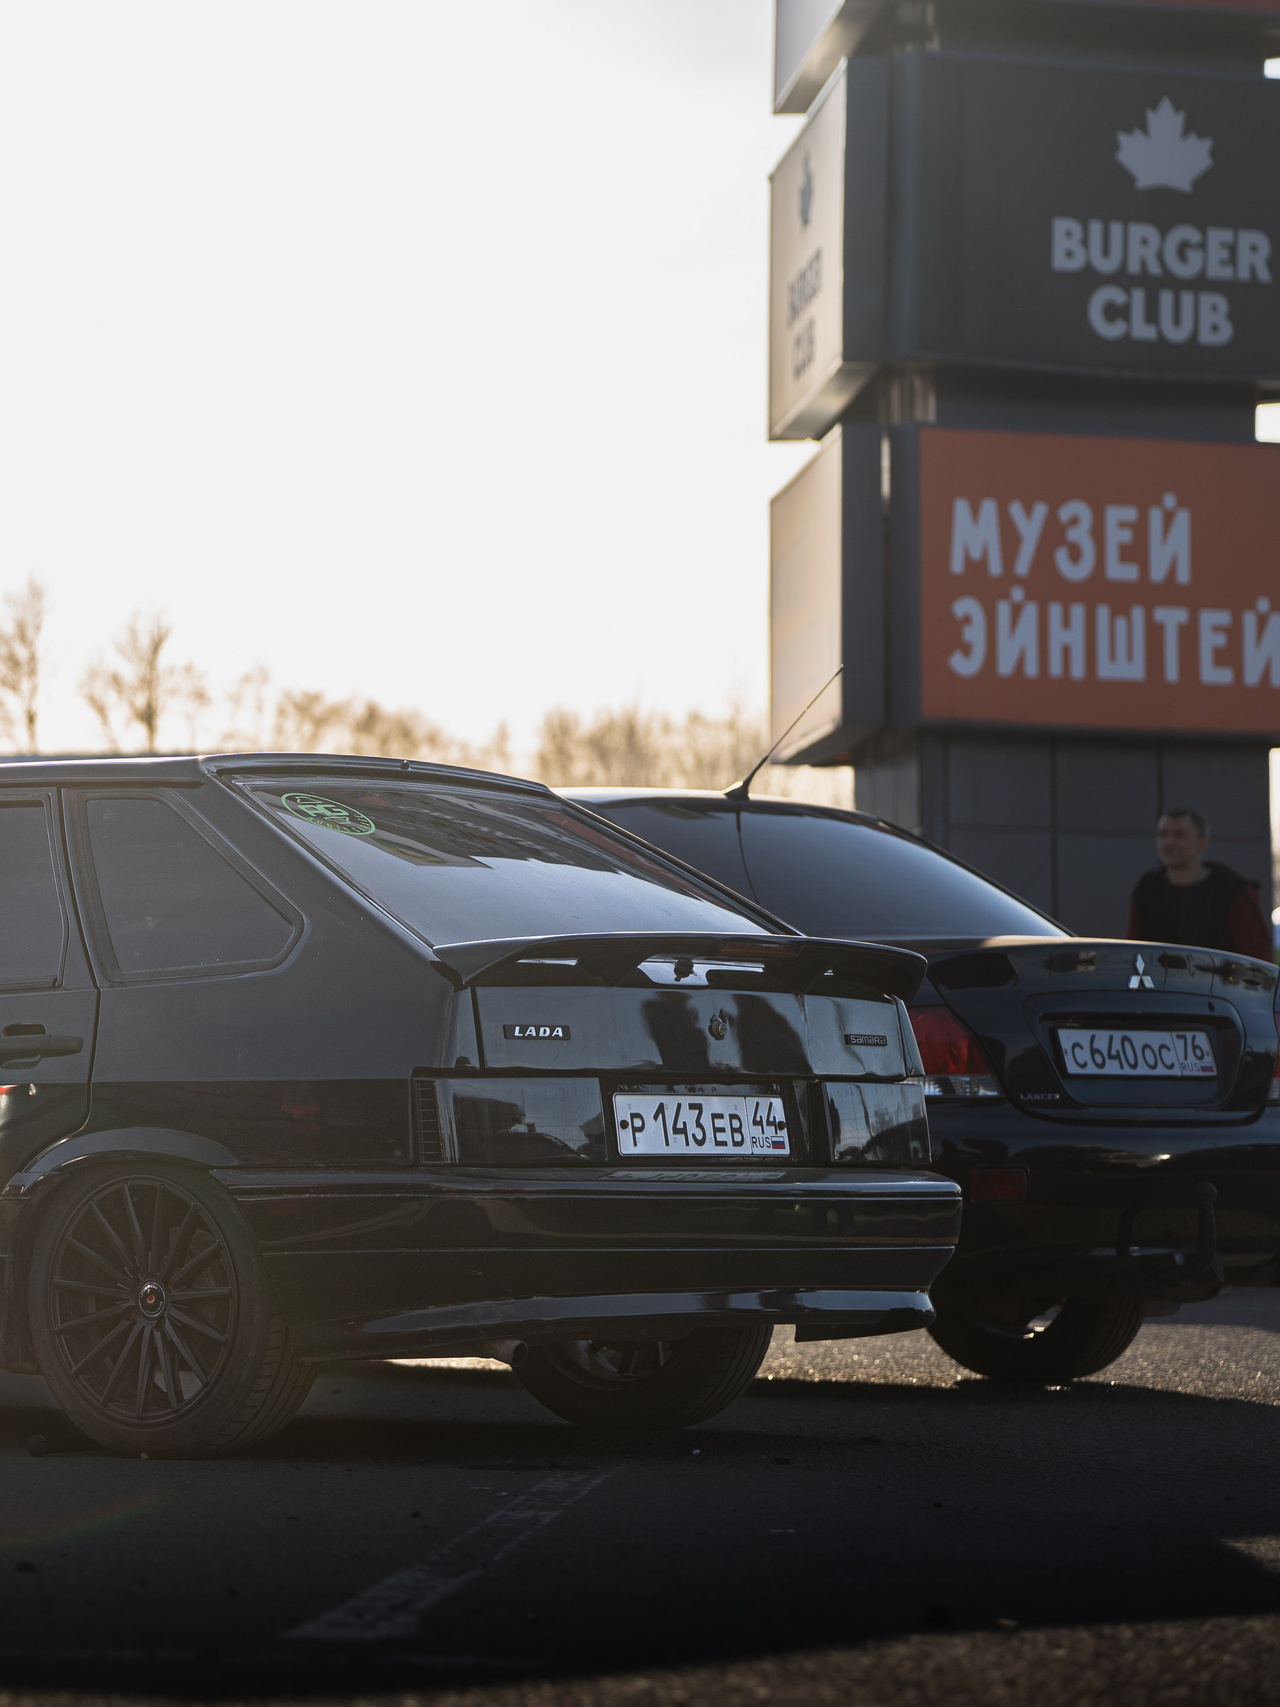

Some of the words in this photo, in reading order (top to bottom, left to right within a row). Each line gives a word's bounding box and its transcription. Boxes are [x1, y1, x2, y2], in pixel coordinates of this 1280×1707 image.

[1051, 215, 1273, 284] BURGER
[1087, 284, 1234, 347] CLUB
[949, 492, 1192, 585] МУЗЕЙ
[947, 586, 1280, 688] ЭЙНШТЕЙ
[514, 1026, 563, 1037] LADA
[1176, 1034, 1205, 1061] 76
[1180, 1062, 1200, 1072] RUS
[752, 1101, 779, 1135] 44
[751, 1136, 771, 1148] RUS
